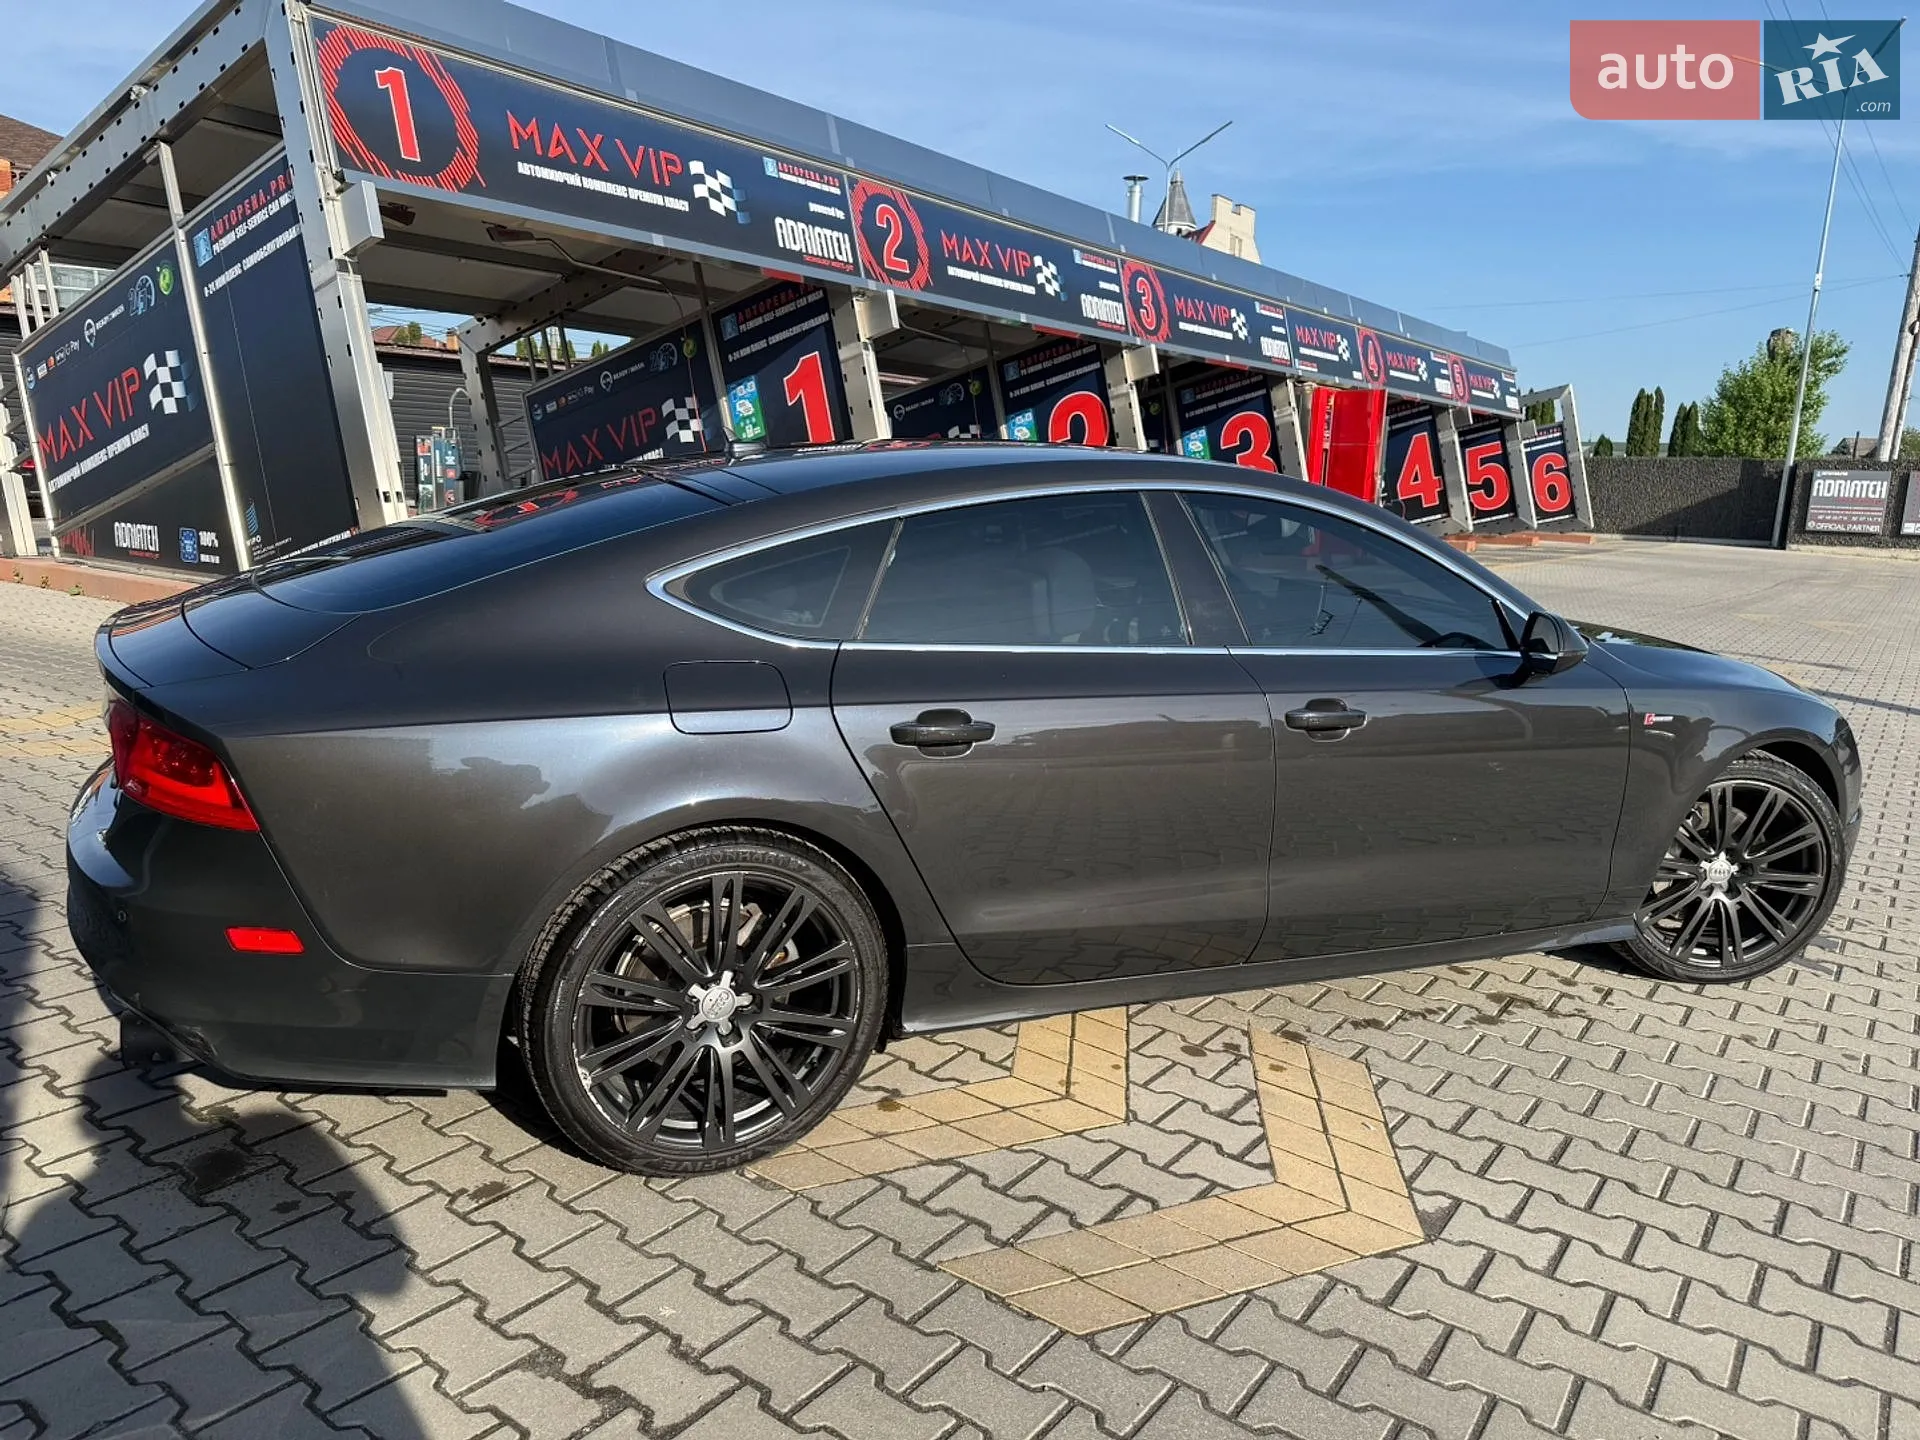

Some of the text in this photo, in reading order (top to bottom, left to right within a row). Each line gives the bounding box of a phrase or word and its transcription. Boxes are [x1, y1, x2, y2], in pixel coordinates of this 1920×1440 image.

[374, 66, 421, 162] 1
[506, 109, 684, 187] MAX VIP
[875, 203, 910, 273] 2
[940, 229, 1032, 277] MAX VIP
[1136, 277, 1157, 330] 3
[1173, 293, 1207, 322] MAX
[1207, 302, 1230, 326] VIP
[1295, 323, 1336, 351] MAX VIP
[1368, 340, 1378, 377] 4
[38, 367, 141, 470] MAX VIP
[783, 351, 835, 443] 1
[542, 407, 656, 479] MAX VIP
[1220, 411, 1277, 473] 3
[1397, 432, 1443, 508] 4
[1466, 441, 1510, 511] 5
[1532, 452, 1571, 512] 6
[1816, 522, 1880, 533] OFFICIAL PARTNER
